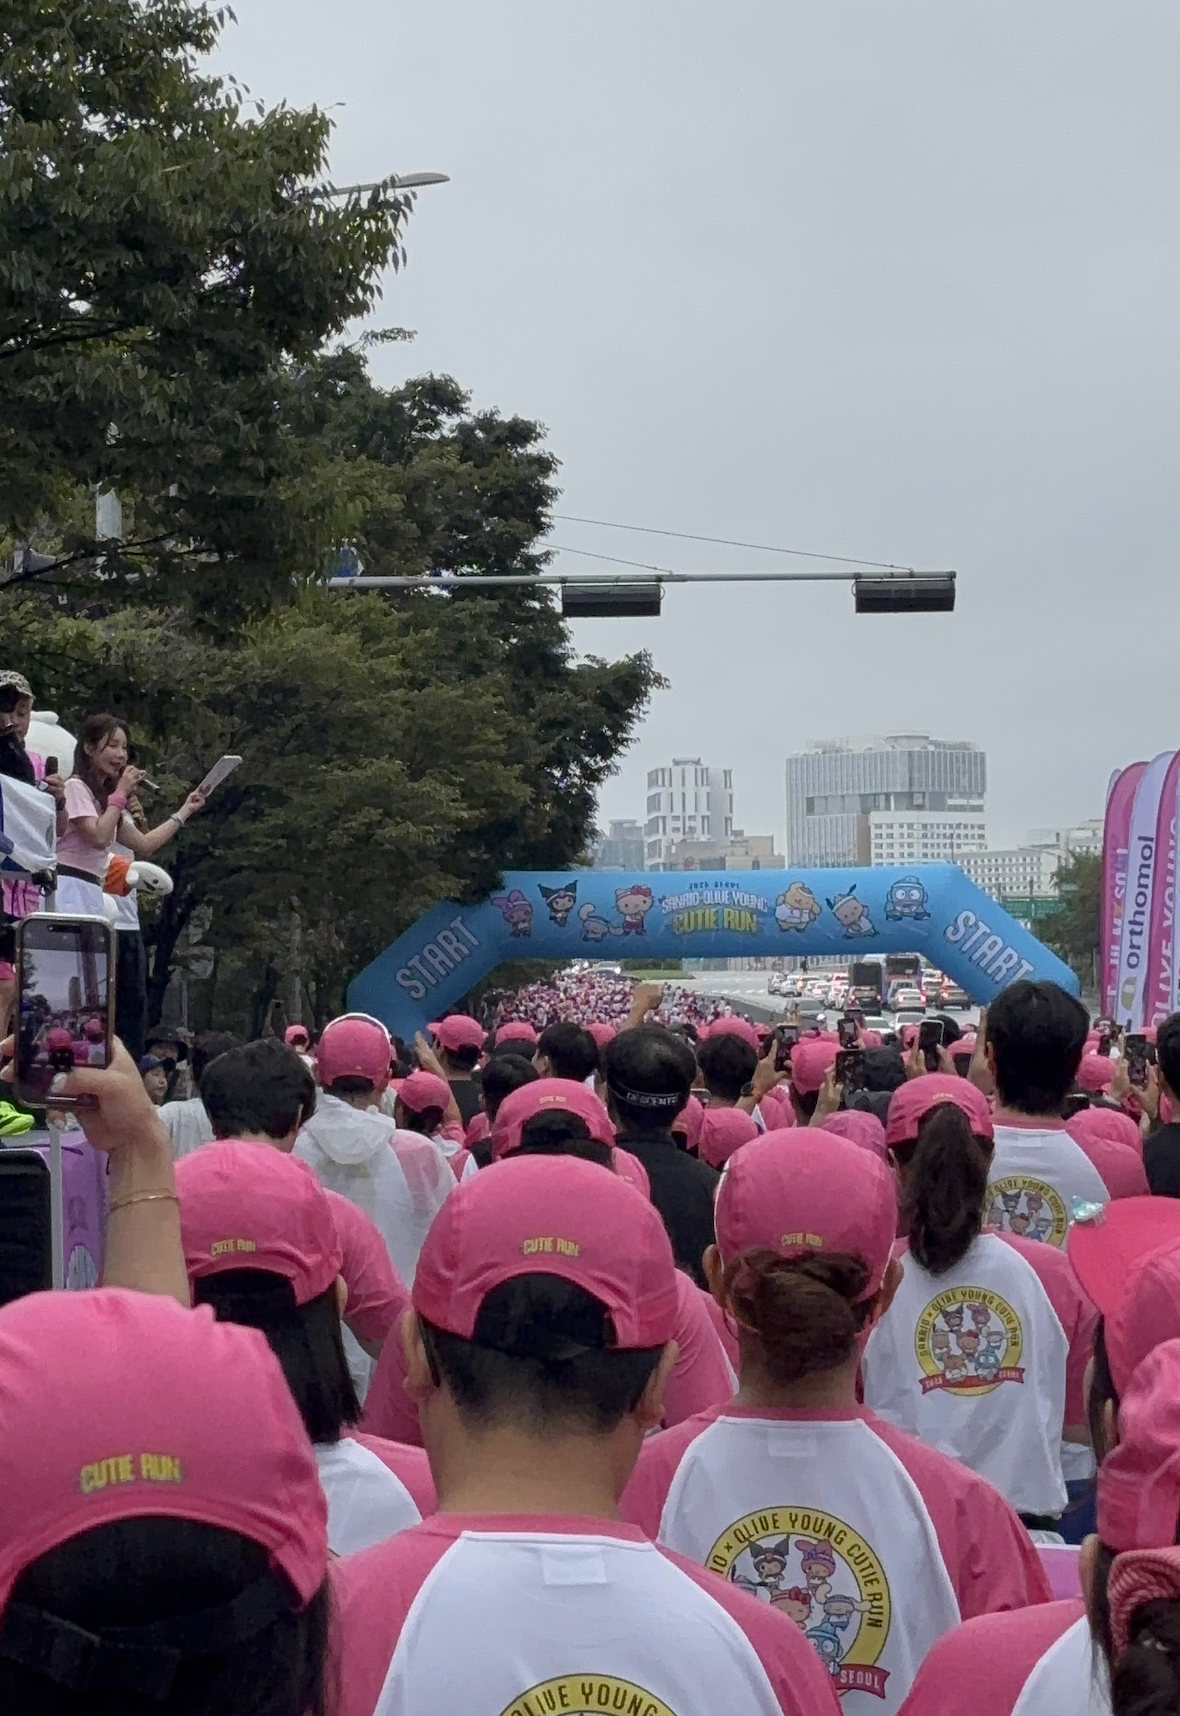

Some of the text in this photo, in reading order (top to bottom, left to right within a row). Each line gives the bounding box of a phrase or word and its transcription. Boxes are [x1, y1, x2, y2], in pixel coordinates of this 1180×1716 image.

[1126, 835, 1155, 969] orthomol
[672, 908, 759, 935] CUTIE RUN
[394, 914, 479, 999] START
[945, 910, 1034, 985] START
[556, 1237, 579, 1257] RUN
[961, 1289, 994, 1307] YOUNG
[140, 1452, 181, 1484] RUN
[733, 1513, 780, 1544] OLIVE
[789, 1512, 847, 1546] YOUNG
[846, 1543, 880, 1588] CUTIE
[866, 1591, 884, 1629] RUN
[839, 1670, 881, 1689] SEOUL
